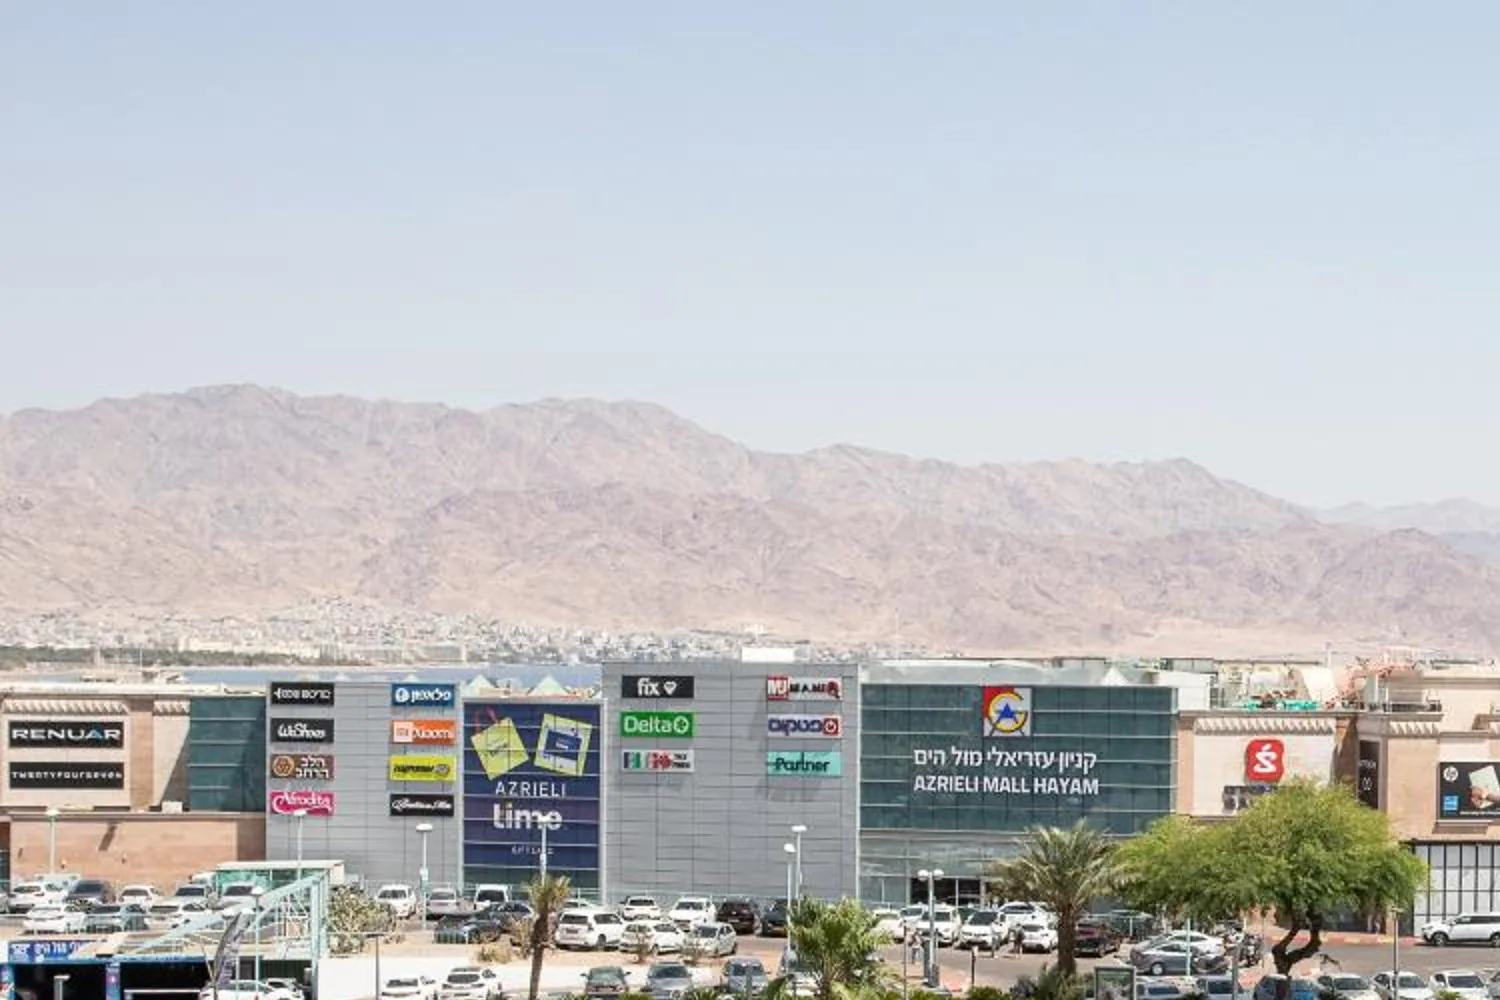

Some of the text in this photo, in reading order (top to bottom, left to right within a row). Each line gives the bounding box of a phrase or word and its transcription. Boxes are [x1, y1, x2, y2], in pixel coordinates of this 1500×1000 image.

[638, 677, 660, 696] fix
[624, 715, 673, 733] Delta
[11, 728, 122, 740] RENUAR
[774, 753, 830, 772] Partner
[913, 745, 1097, 775] קניון עזריאלי מול הים
[495, 781, 567, 797] AZRIELI
[913, 775, 1099, 796] AZRIELI MALL HAYAM
[492, 802, 564, 831] time
